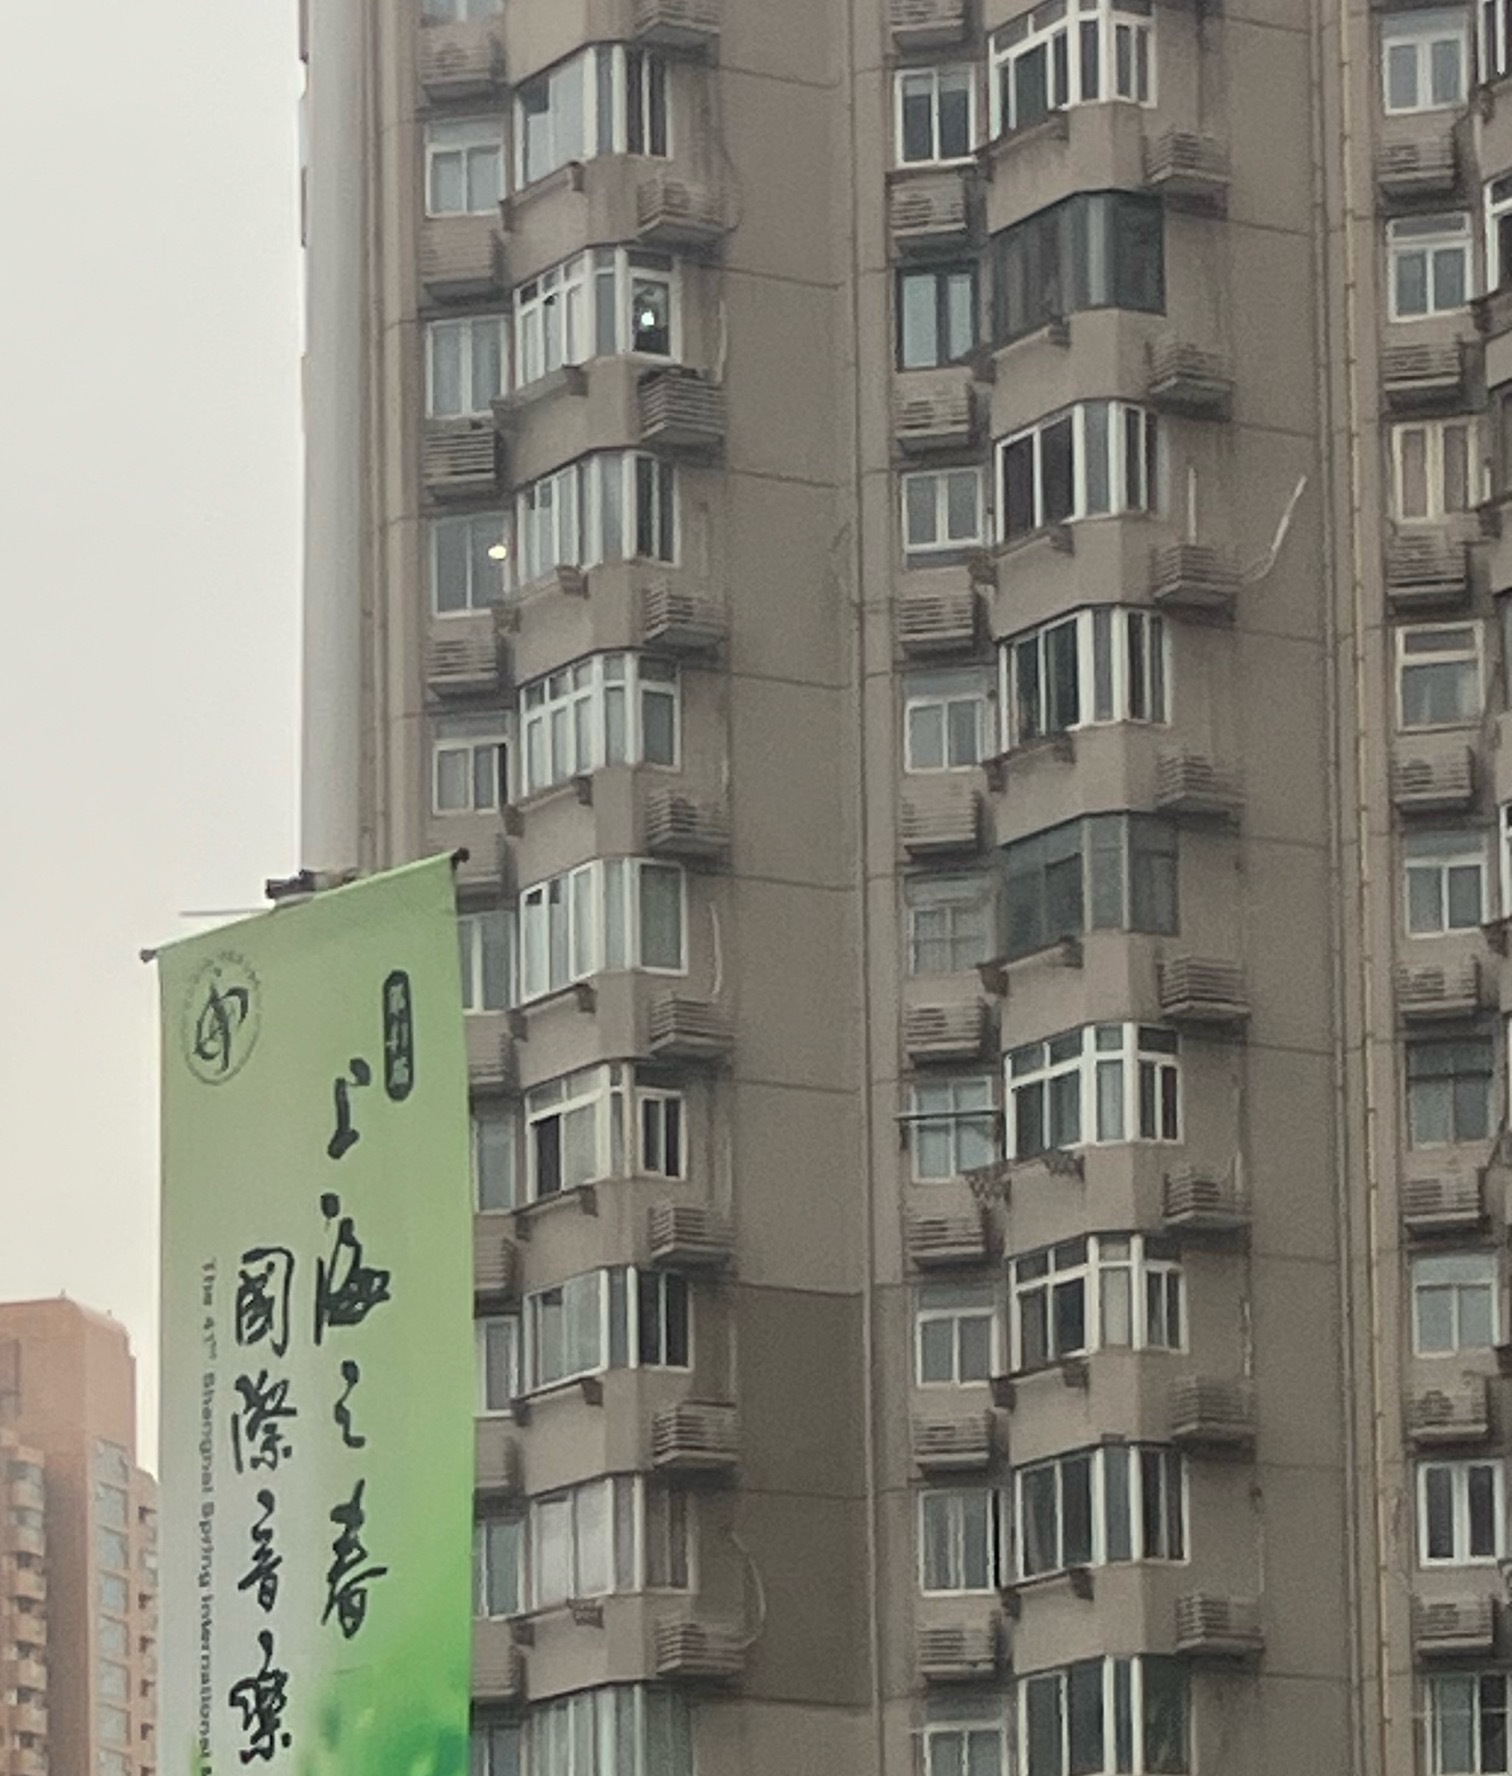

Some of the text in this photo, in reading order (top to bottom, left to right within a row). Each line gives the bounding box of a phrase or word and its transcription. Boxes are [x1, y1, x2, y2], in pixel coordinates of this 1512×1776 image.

[201, 1256, 217, 1305] The
[199, 1372, 216, 1493] Shanghai
[197, 1501, 215, 1588] Spring
[199, 1594, 214, 1758] International
